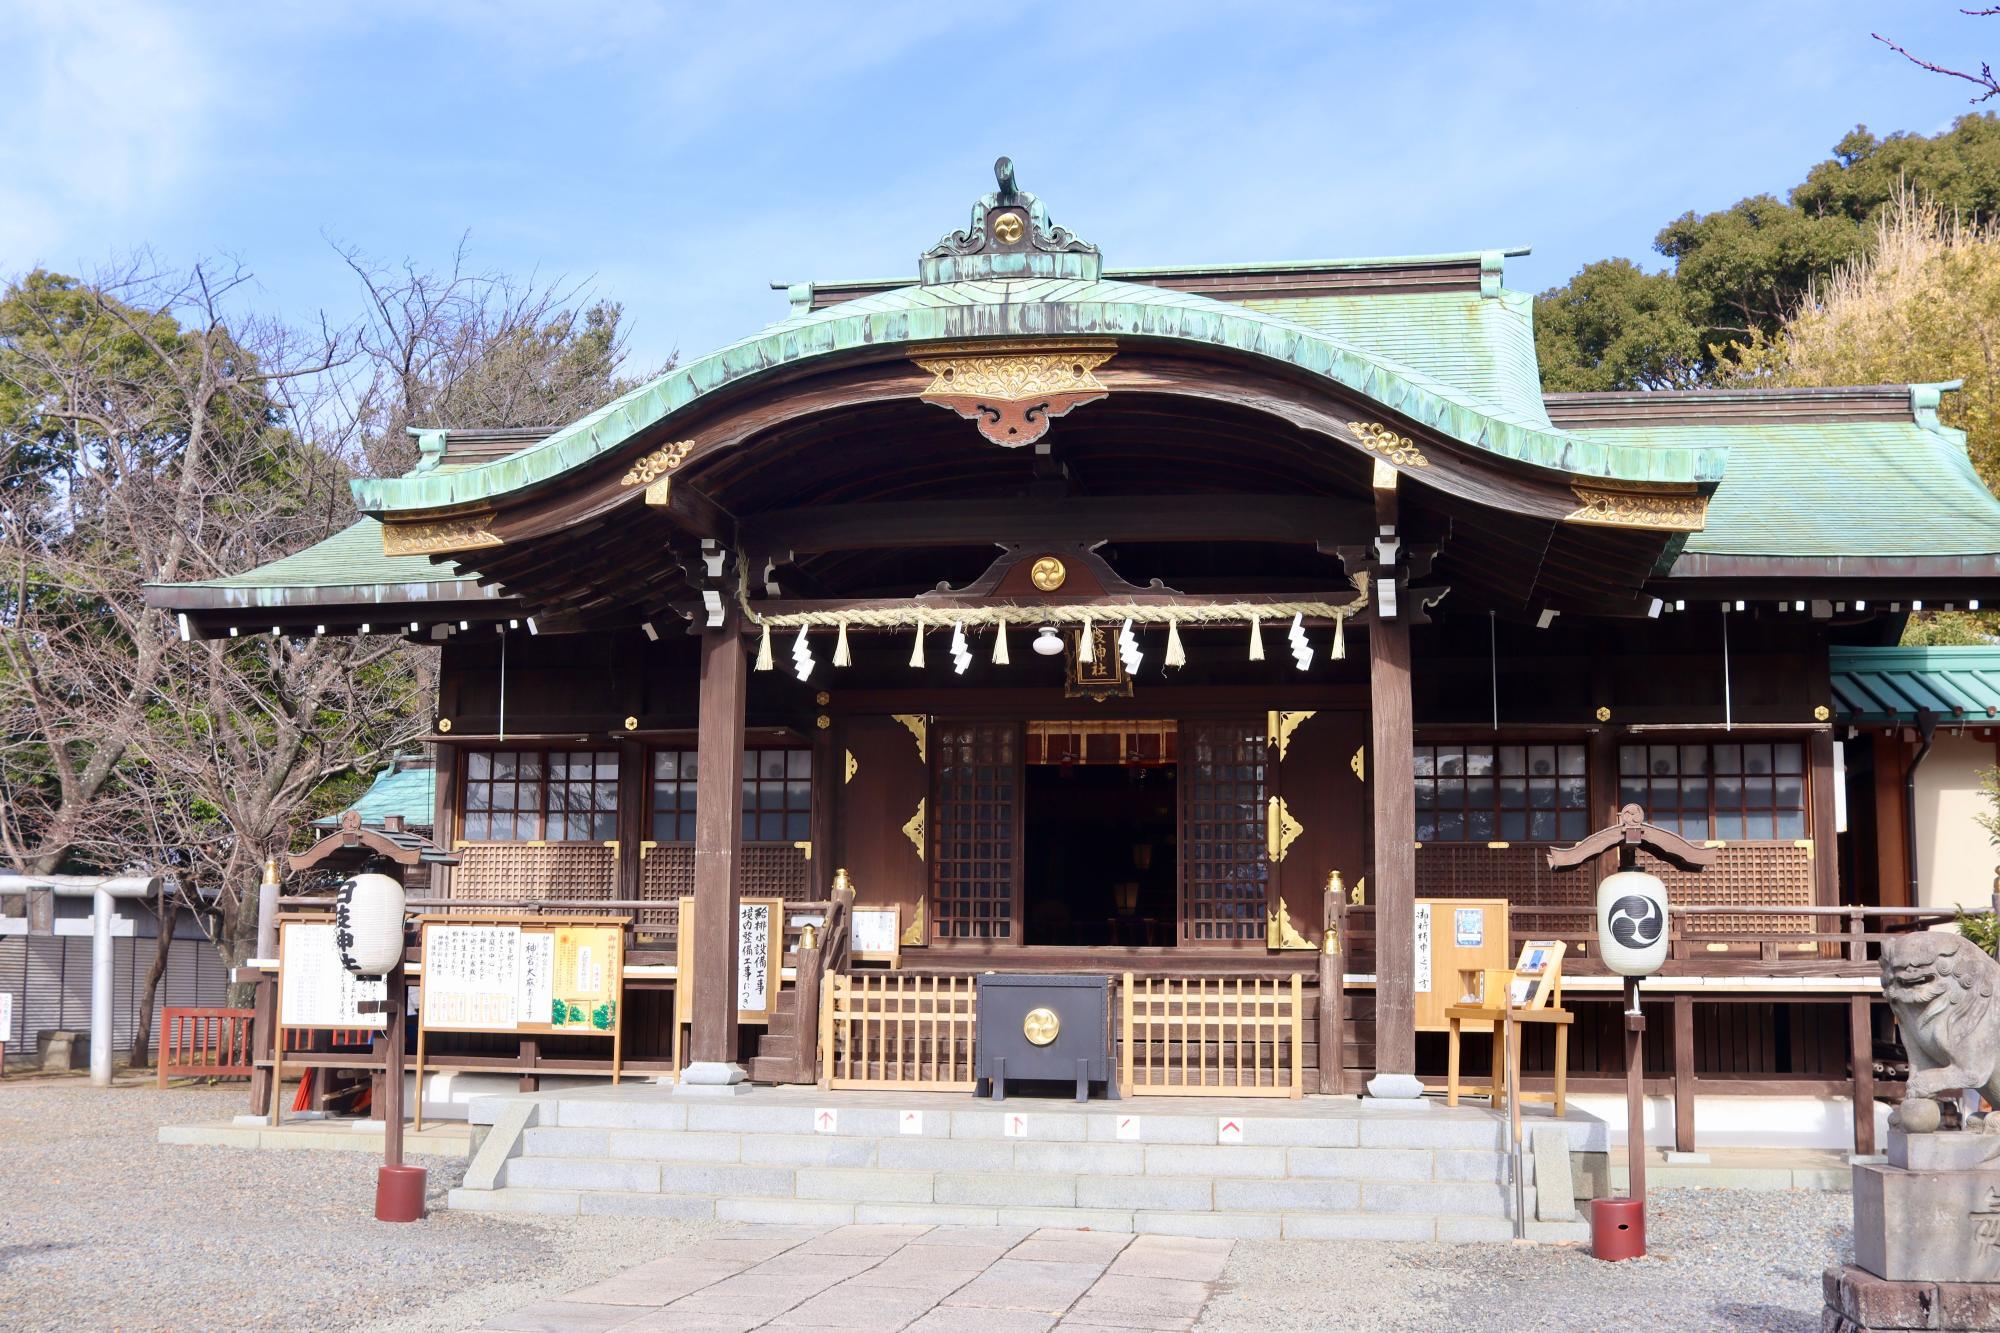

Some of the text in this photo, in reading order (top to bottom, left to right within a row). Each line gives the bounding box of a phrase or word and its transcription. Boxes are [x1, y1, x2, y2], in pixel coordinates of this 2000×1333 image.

[755, 906, 768, 995] 給排水設備工事
